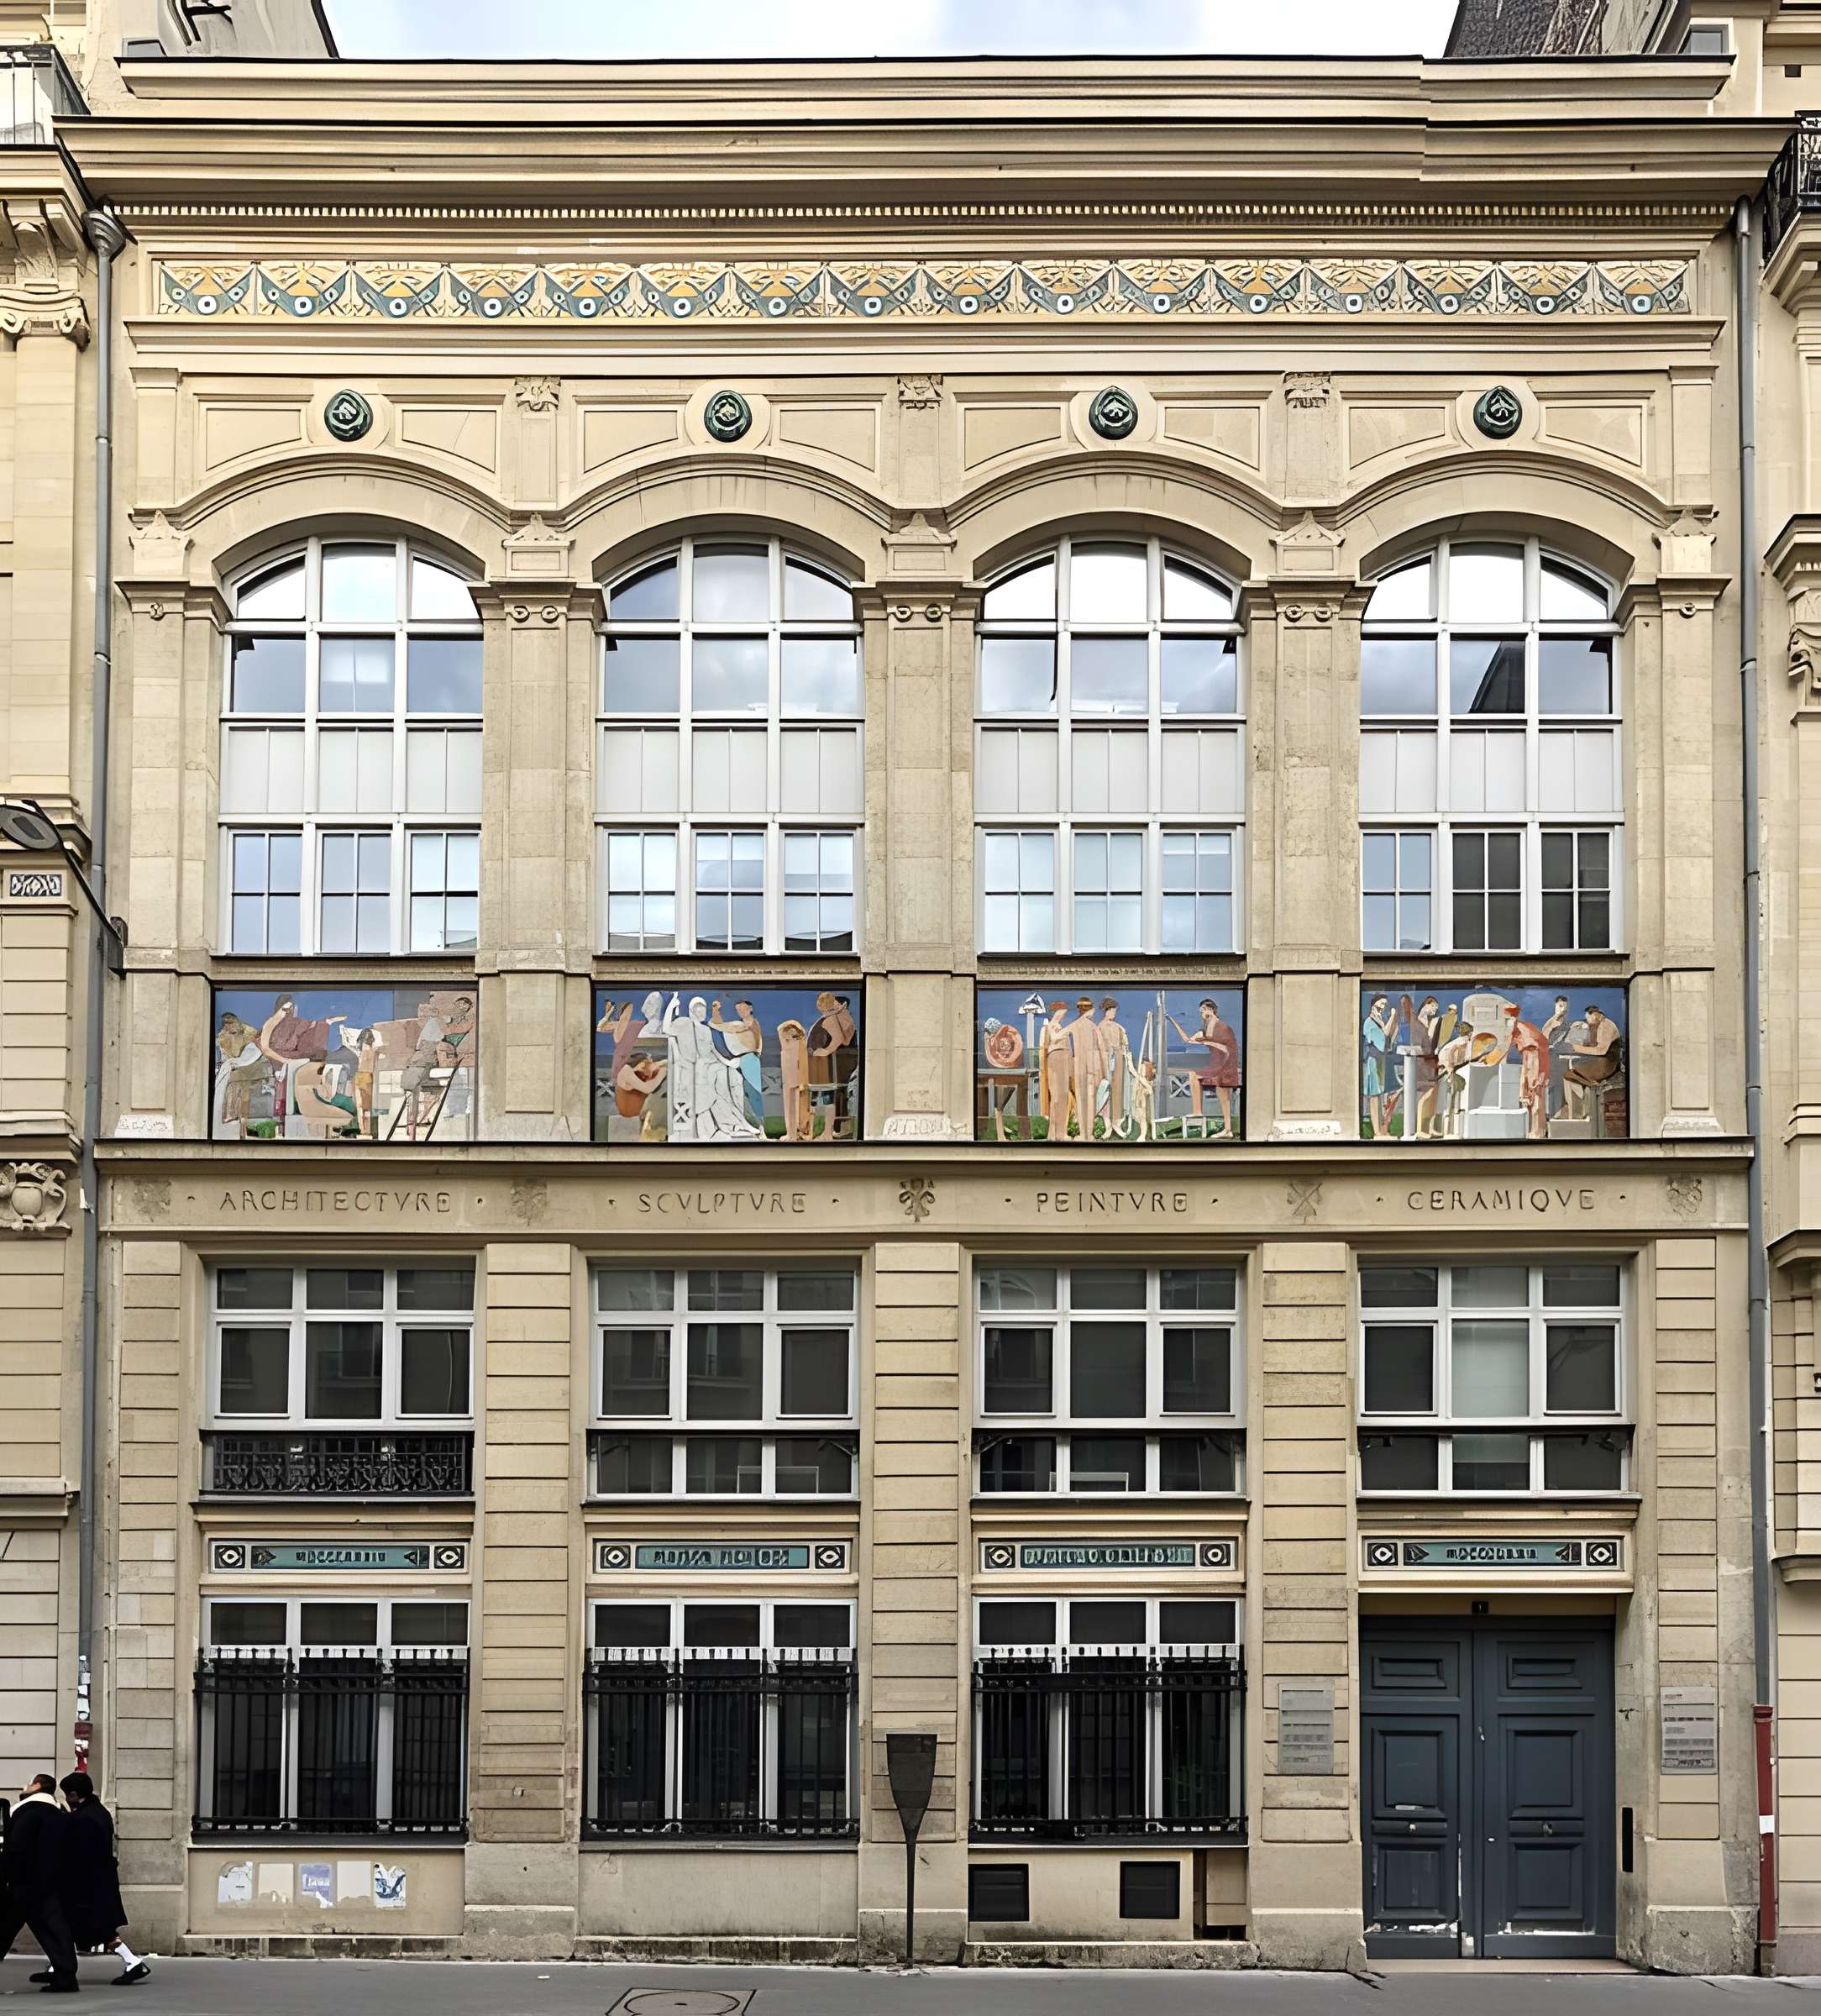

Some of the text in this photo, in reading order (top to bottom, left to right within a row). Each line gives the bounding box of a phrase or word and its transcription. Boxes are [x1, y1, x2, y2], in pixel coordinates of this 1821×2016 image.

[638, 1193, 806, 1214] SCVLPTVRE
[1036, 1191, 1189, 1213] PEINTVRE
[1407, 1189, 1594, 1212] CERAMIQVE
